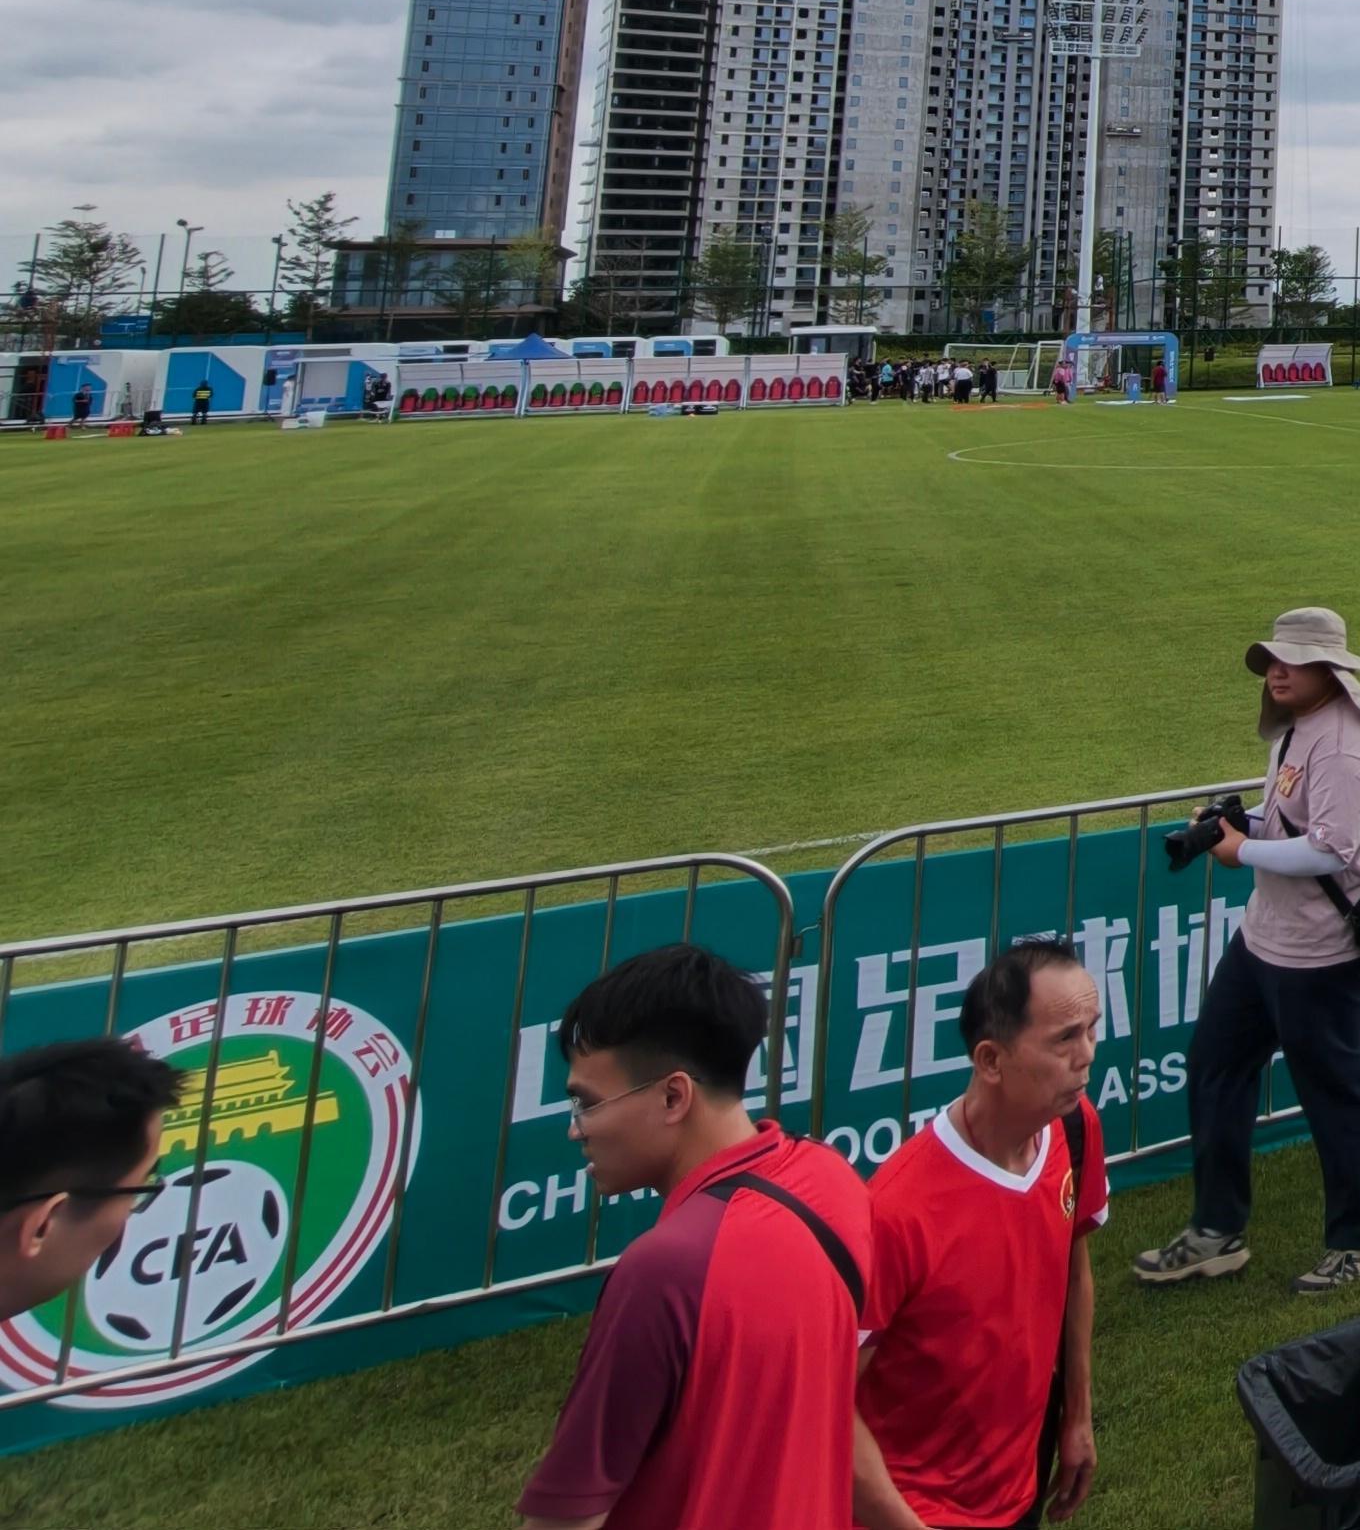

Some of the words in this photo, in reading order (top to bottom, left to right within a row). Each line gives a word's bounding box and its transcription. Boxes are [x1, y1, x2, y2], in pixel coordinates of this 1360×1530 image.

[128, 995, 402, 1078] 足球协会
[130, 1222, 249, 1286] CFA
